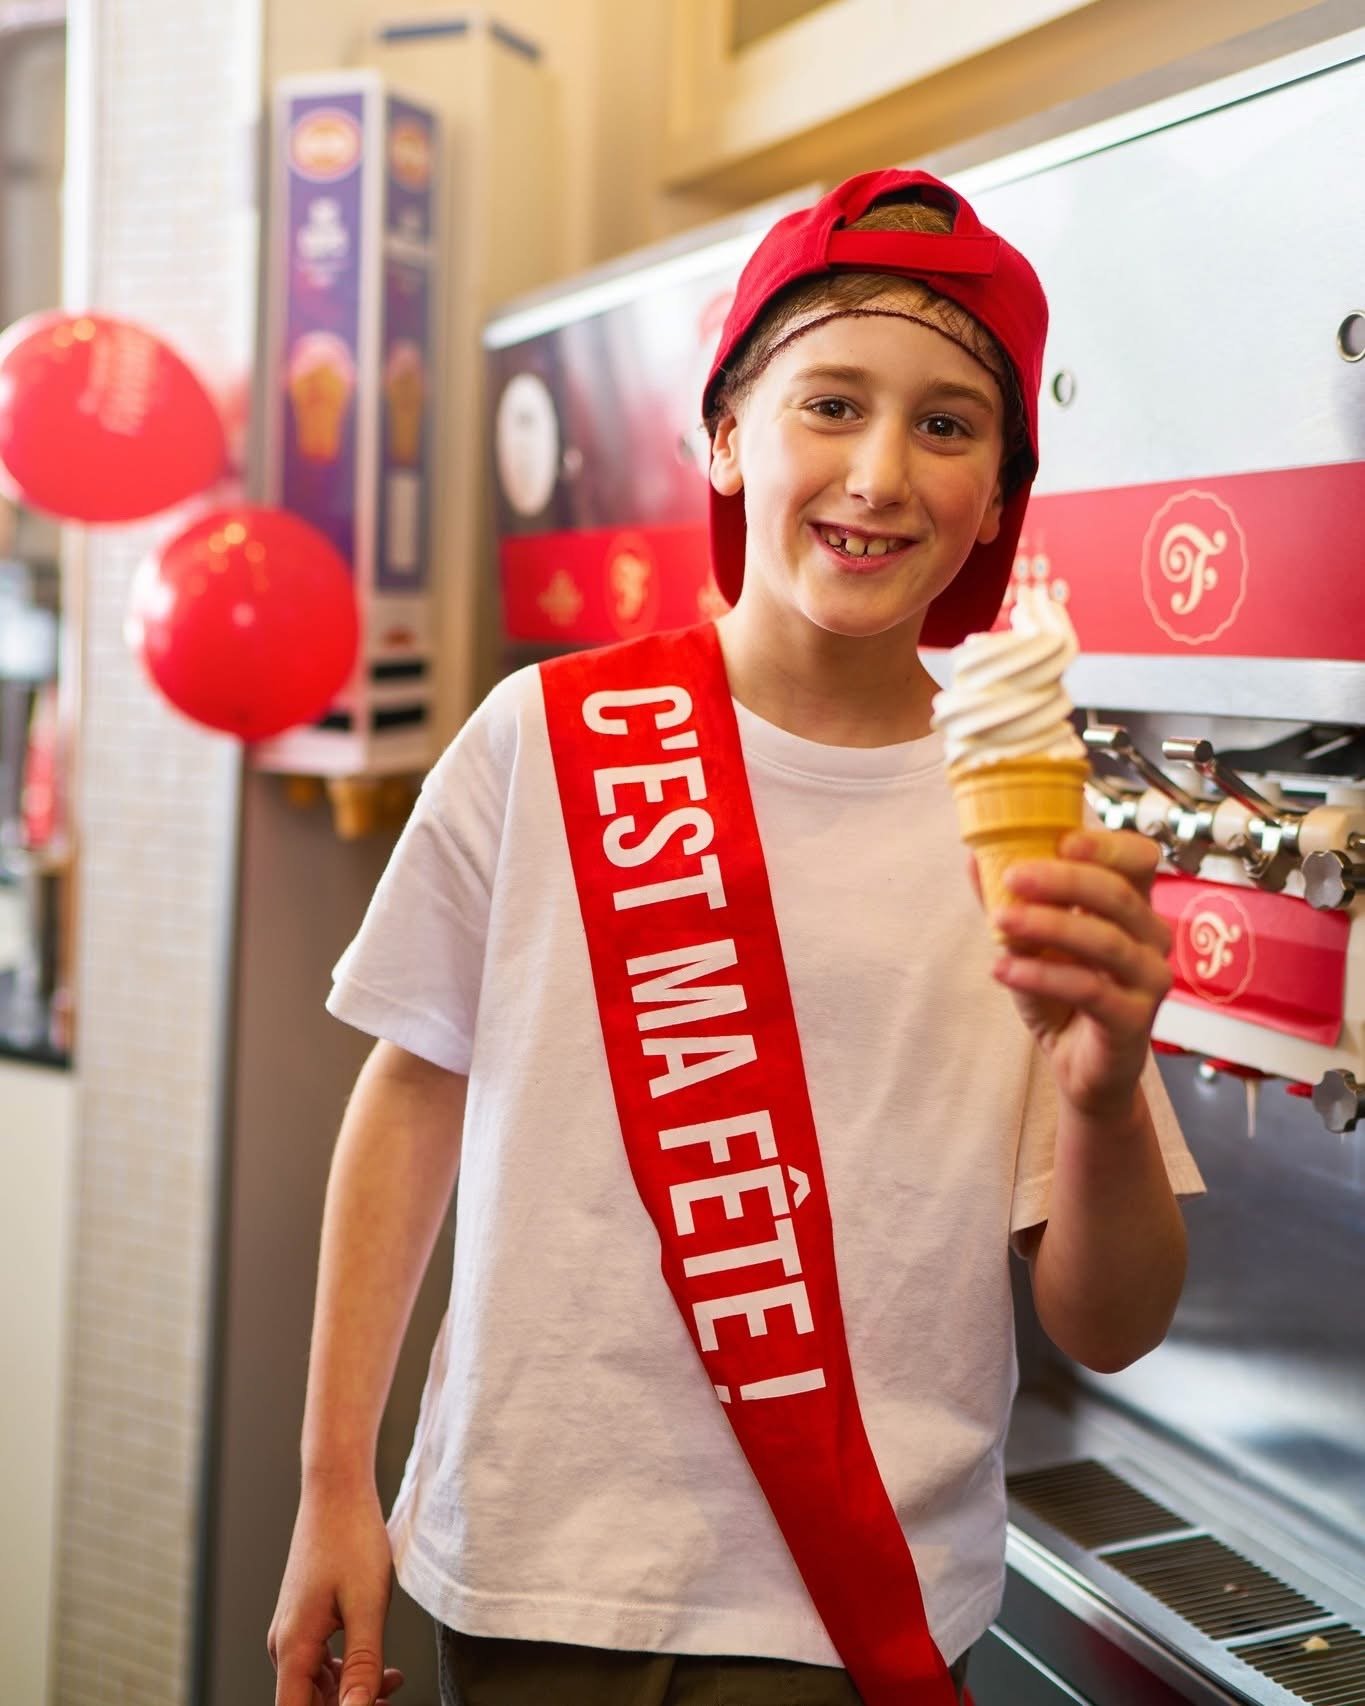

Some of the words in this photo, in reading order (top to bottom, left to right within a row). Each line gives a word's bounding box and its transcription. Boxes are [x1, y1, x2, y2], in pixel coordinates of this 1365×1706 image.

[582, 685, 727, 911] C'EST
[626, 938, 758, 1099] MA
[658, 1109, 815, 1352] FÊTE
